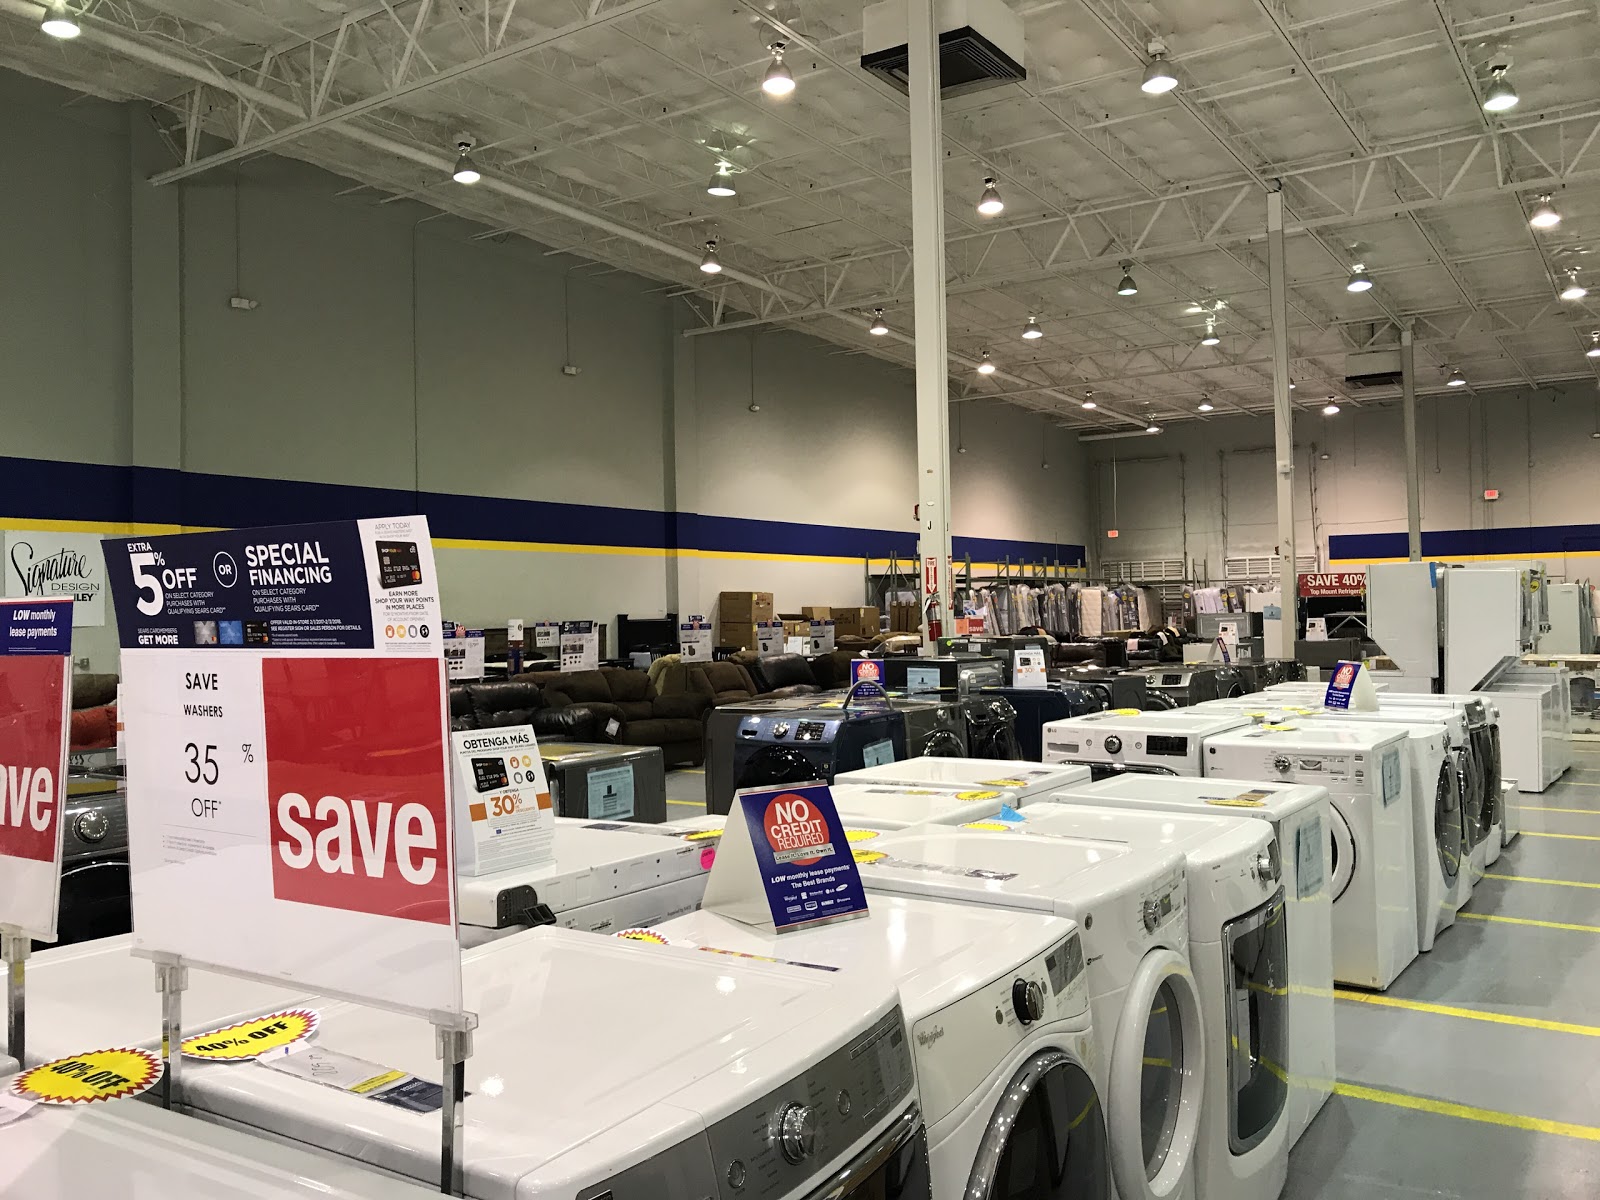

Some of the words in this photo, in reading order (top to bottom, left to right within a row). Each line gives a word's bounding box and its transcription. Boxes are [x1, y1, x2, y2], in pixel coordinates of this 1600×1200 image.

[127, 542, 152, 552] EXTRA
[245, 541, 330, 567] SPECIAL
[11, 541, 92, 596] Signature
[218, 564, 232, 575] OR
[249, 566, 332, 586] FINANCING
[51, 582, 100, 590] DESIGN
[1307, 574, 1339, 586] SAVE
[13, 610, 30, 620] LOW
[31, 609, 56, 622] monthly
[10, 626, 26, 637] lease
[138, 635, 153, 645] GET
[155, 635, 179, 644] MORE
[1342, 667, 1352, 675] NO
[185, 672, 218, 690] SAVE
[184, 704, 223, 718] WASHERS
[464, 736, 508, 749] OBTENGA
[510, 732, 530, 744] MÁS
[184, 742, 219, 785] 35
[242, 743, 254, 763] %
[490, 793, 522, 816] 30%
[774, 800, 809, 824] NO
[771, 820, 821, 839] CREDIT
[277, 792, 437, 885] save
[777, 833, 824, 850] REQUIRED
[771, 875, 786, 884] LOW
[787, 872, 808, 880] monthly
[816, 876, 835, 884] Brands
[196, 1038, 250, 1051] 40%
[248, 1021, 288, 1039] OFF
[50, 1061, 95, 1079] 40%
[81, 1070, 130, 1089] OFF
